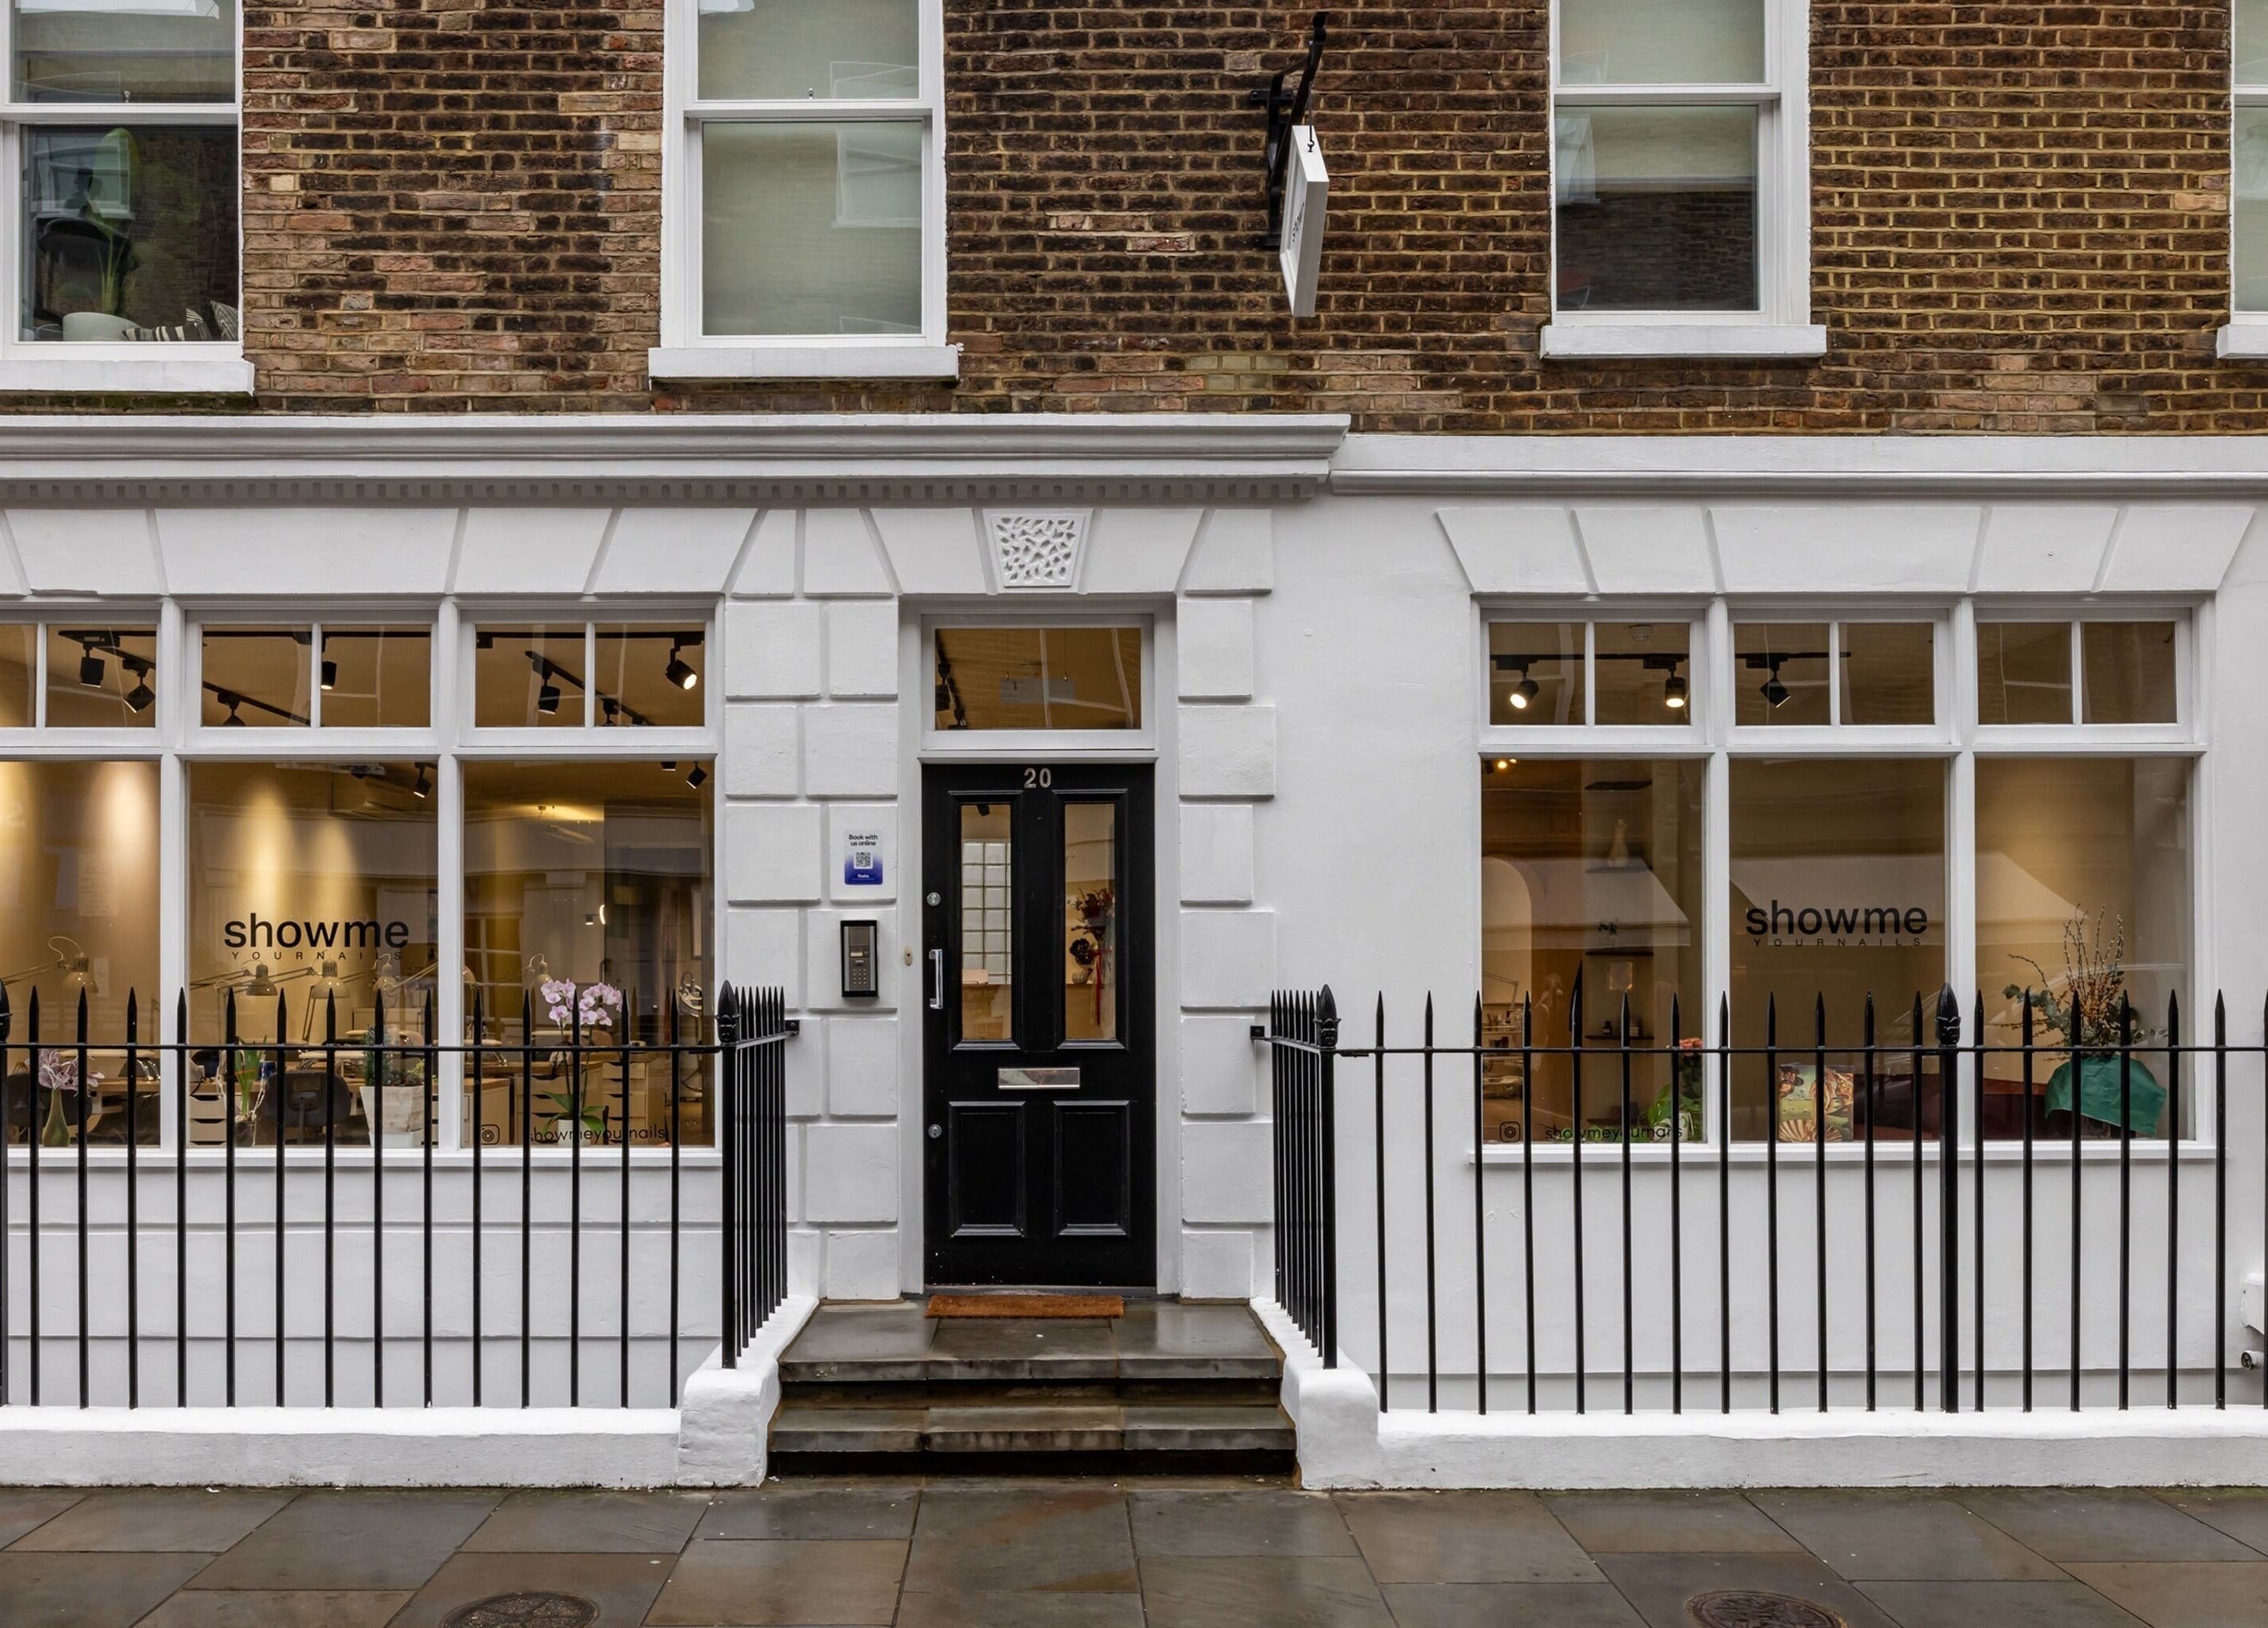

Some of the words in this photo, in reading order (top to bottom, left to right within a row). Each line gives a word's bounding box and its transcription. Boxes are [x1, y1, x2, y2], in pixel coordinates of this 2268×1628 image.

[1023, 767, 1052, 788] 20
[1746, 900, 1927, 934] showme
[224, 913, 408, 948] showme
[1754, 938, 1921, 947] YOURNAILS
[528, 1124, 665, 1144] howeyounails
[1545, 1124, 1683, 1142] shomeyurnais
